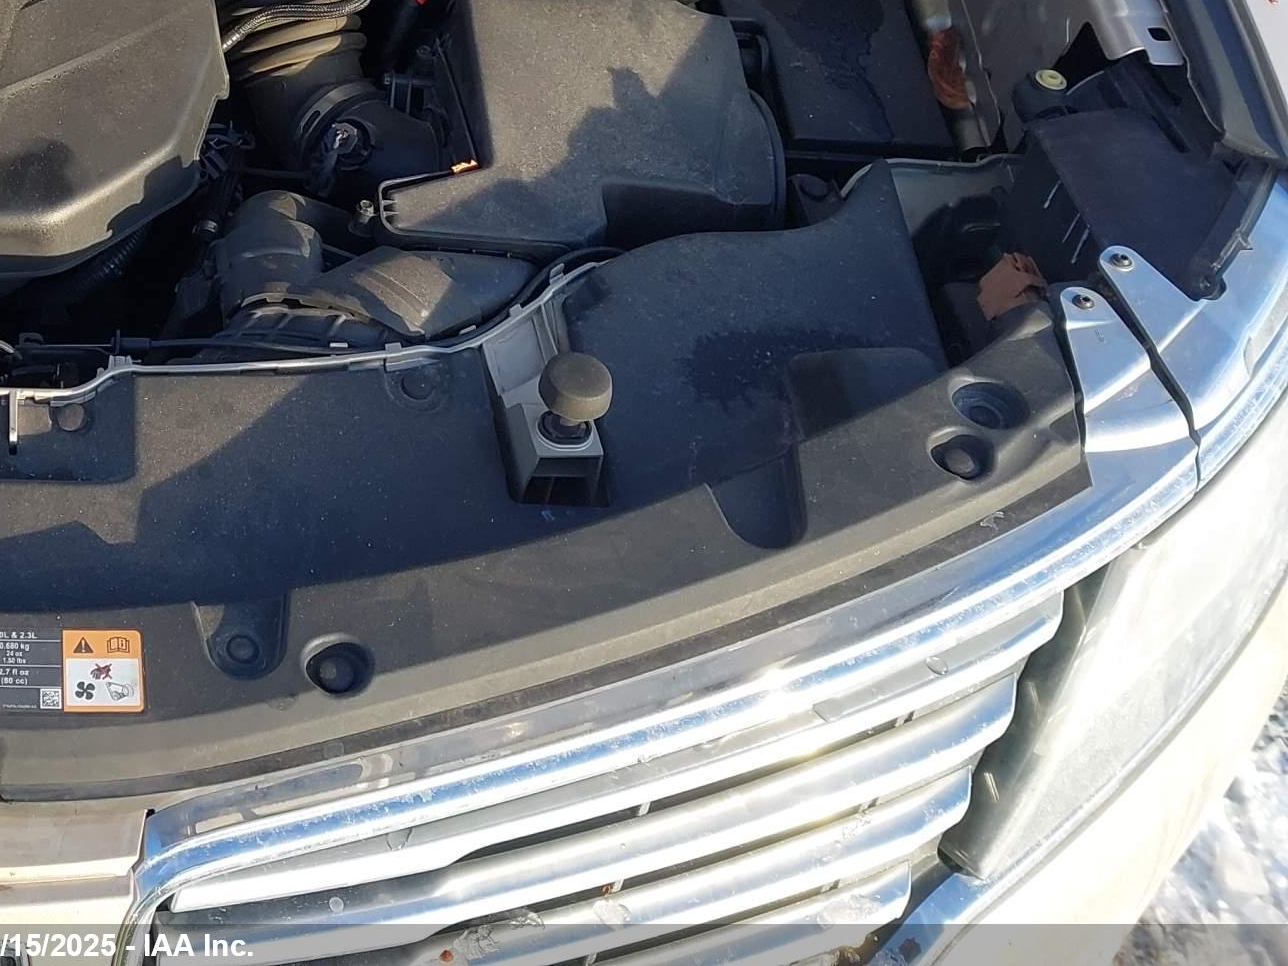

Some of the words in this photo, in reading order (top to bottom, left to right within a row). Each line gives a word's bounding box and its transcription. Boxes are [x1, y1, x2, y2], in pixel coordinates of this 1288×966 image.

[11, 631, 18, 639] &
[19, 631, 38, 639] 2.3L
[0, 642, 19, 650] 0.680
[20, 642, 30, 652] kg
[15, 677, 28, 685] cc)
